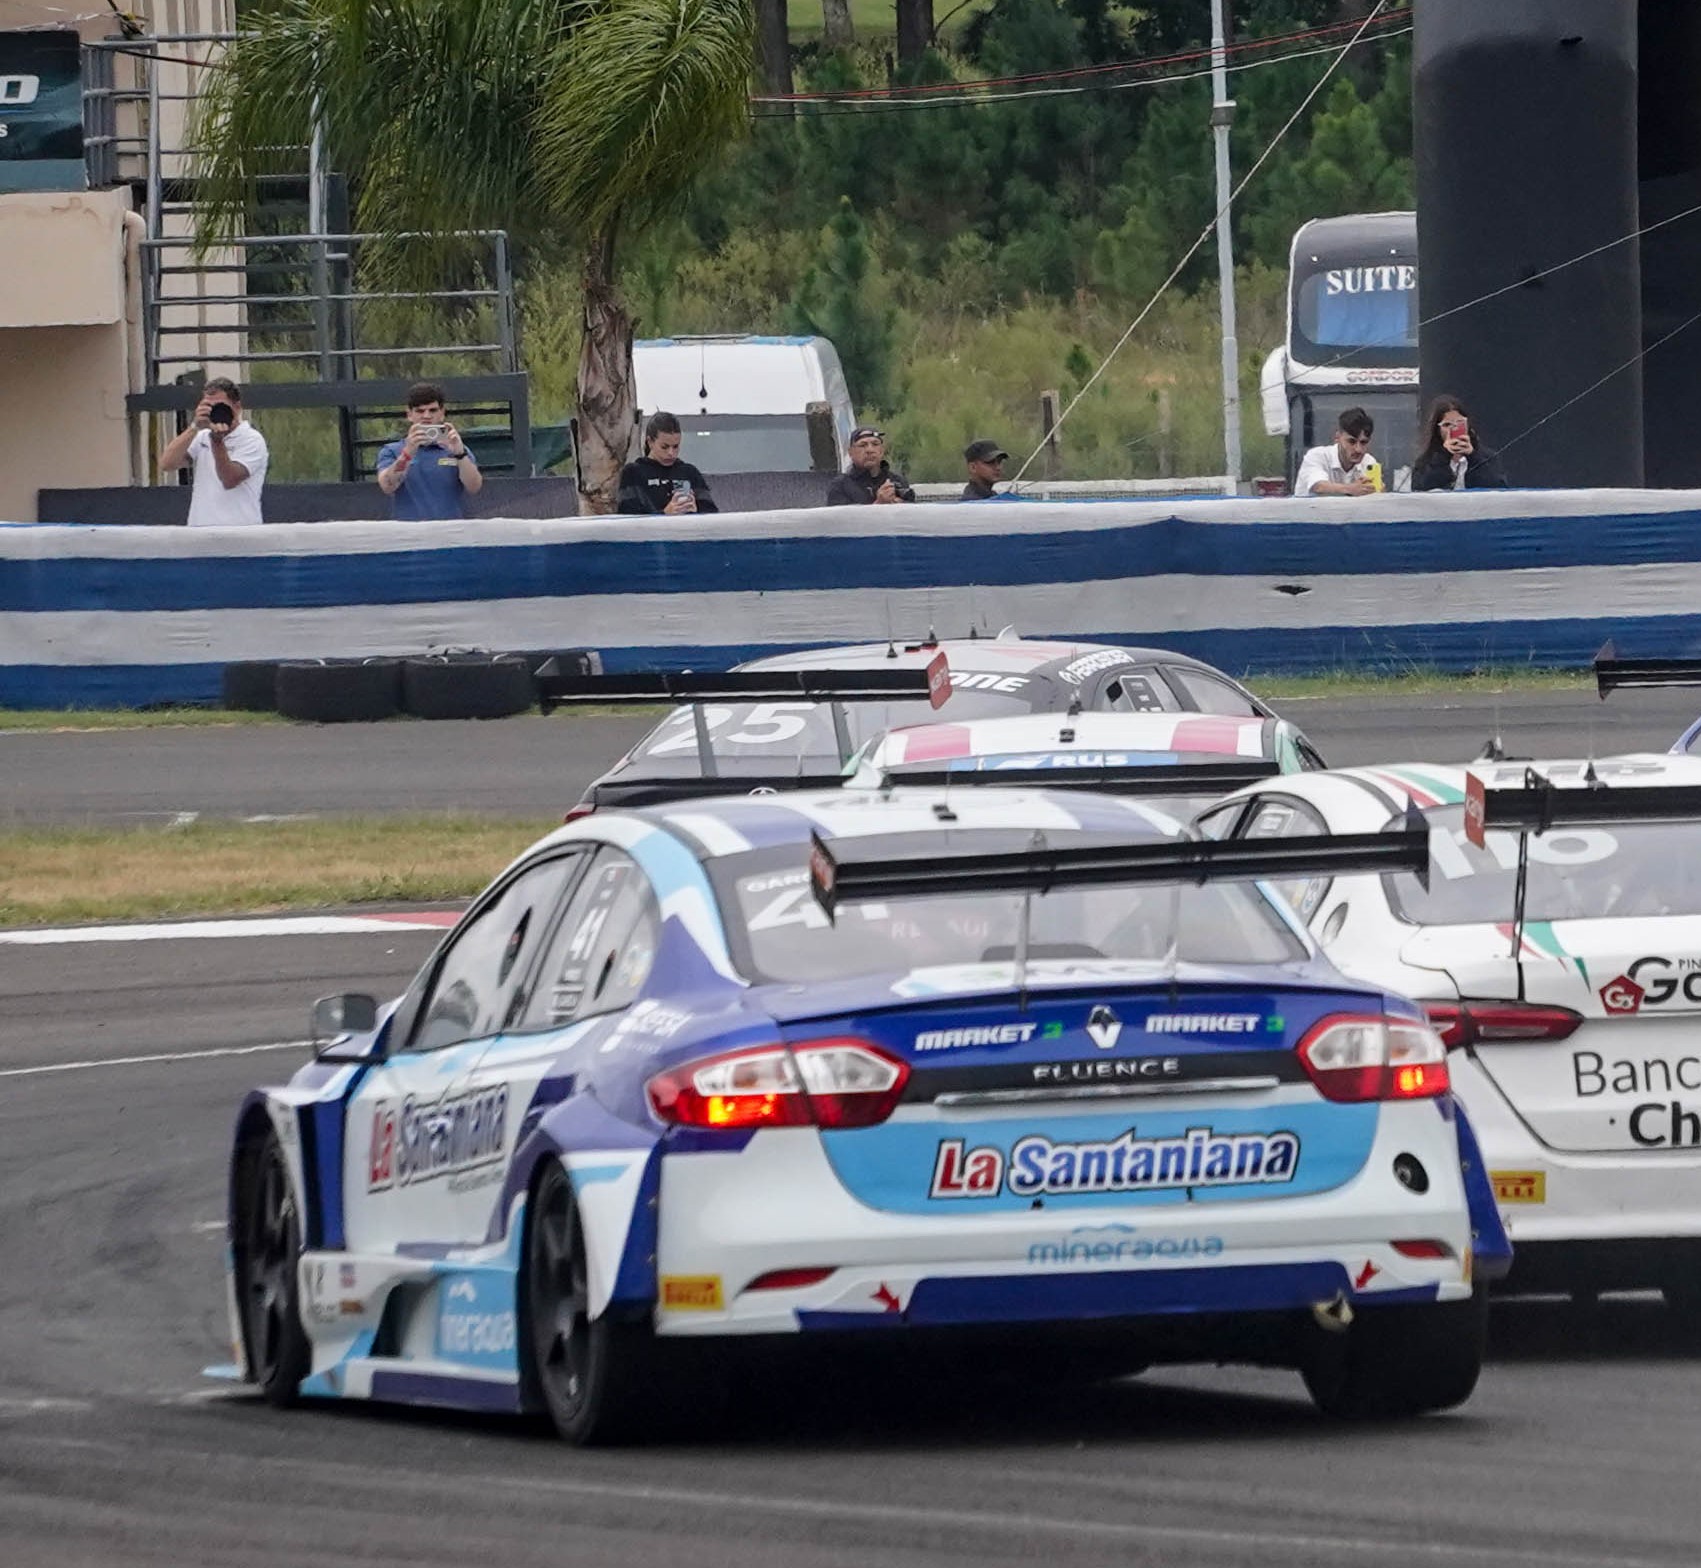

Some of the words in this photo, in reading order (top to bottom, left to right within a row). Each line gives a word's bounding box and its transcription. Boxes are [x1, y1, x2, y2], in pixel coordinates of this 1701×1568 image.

[1326, 264, 1417, 296] SUITE
[646, 702, 818, 756] 25
[914, 1022, 1038, 1052] MARKET
[1145, 1012, 1261, 1034] MARKET
[1032, 1057, 1181, 1083] FLUENCE
[934, 1143, 1001, 1195] La
[1010, 1131, 1300, 1192] Santaniana
